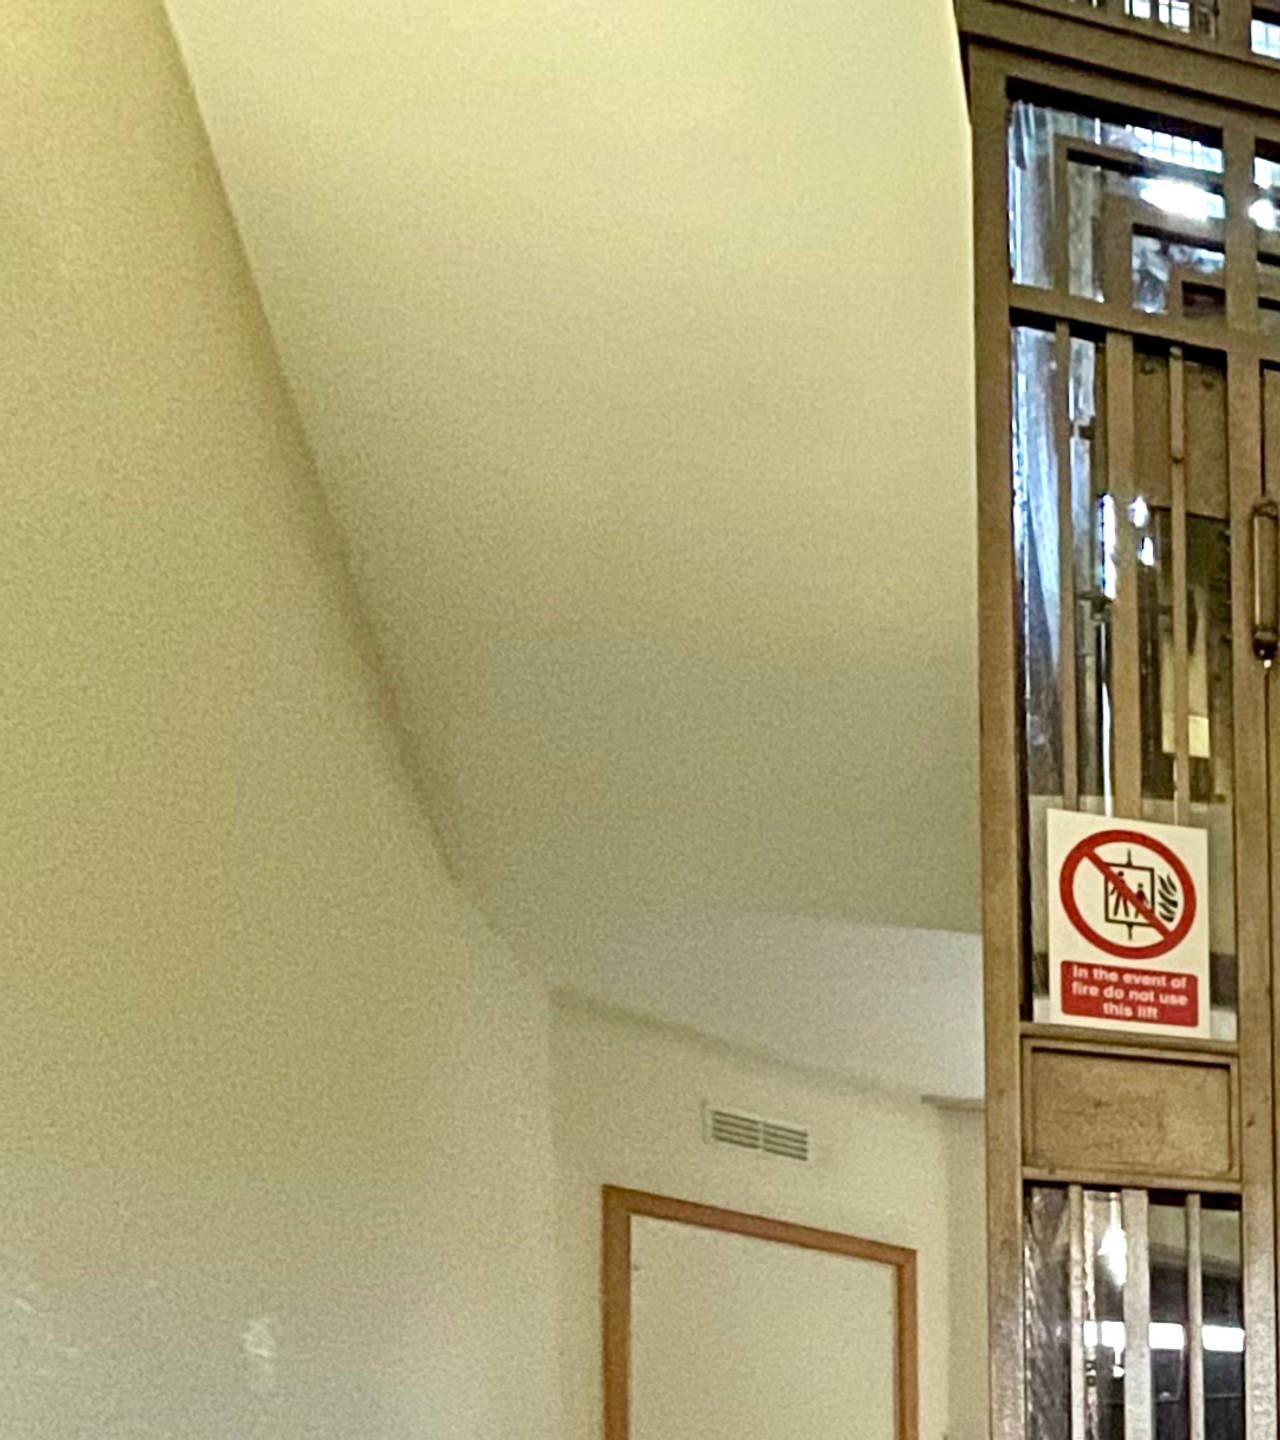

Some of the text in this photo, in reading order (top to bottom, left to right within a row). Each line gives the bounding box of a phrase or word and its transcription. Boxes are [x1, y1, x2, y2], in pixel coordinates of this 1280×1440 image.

[1072, 964, 1188, 989] In the event of
[1072, 980, 1189, 1005] fire do not use
[1103, 1001, 1159, 1019] this lift
